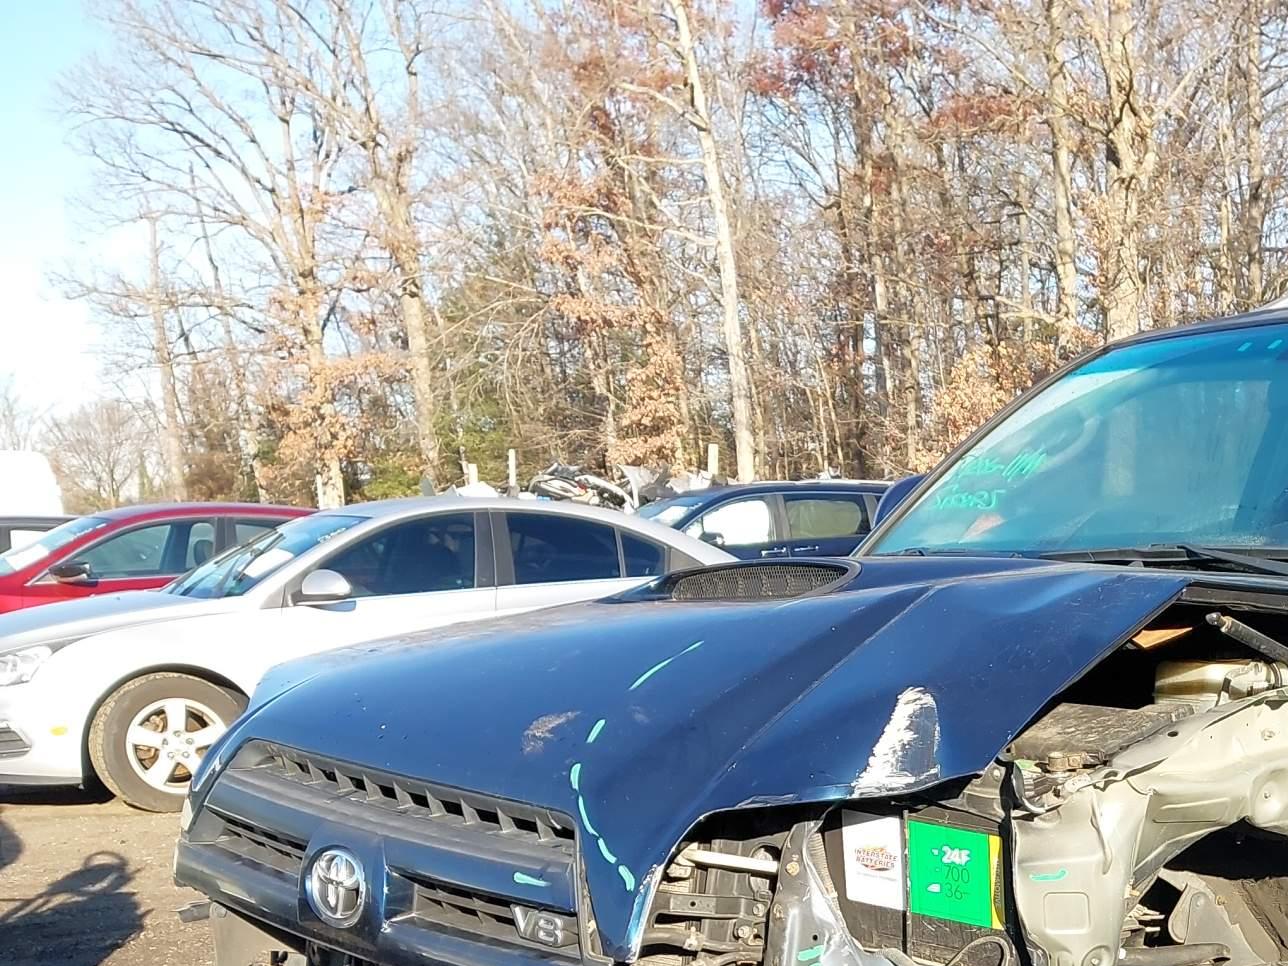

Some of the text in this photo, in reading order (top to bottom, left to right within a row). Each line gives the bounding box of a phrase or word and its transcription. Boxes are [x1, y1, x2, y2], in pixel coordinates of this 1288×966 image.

[854, 848, 898, 862] INTERSTATE
[855, 856, 895, 869] BATTERIES
[941, 845, 972, 866] 24F
[943, 864, 970, 883] 700
[510, 903, 563, 948] V8
